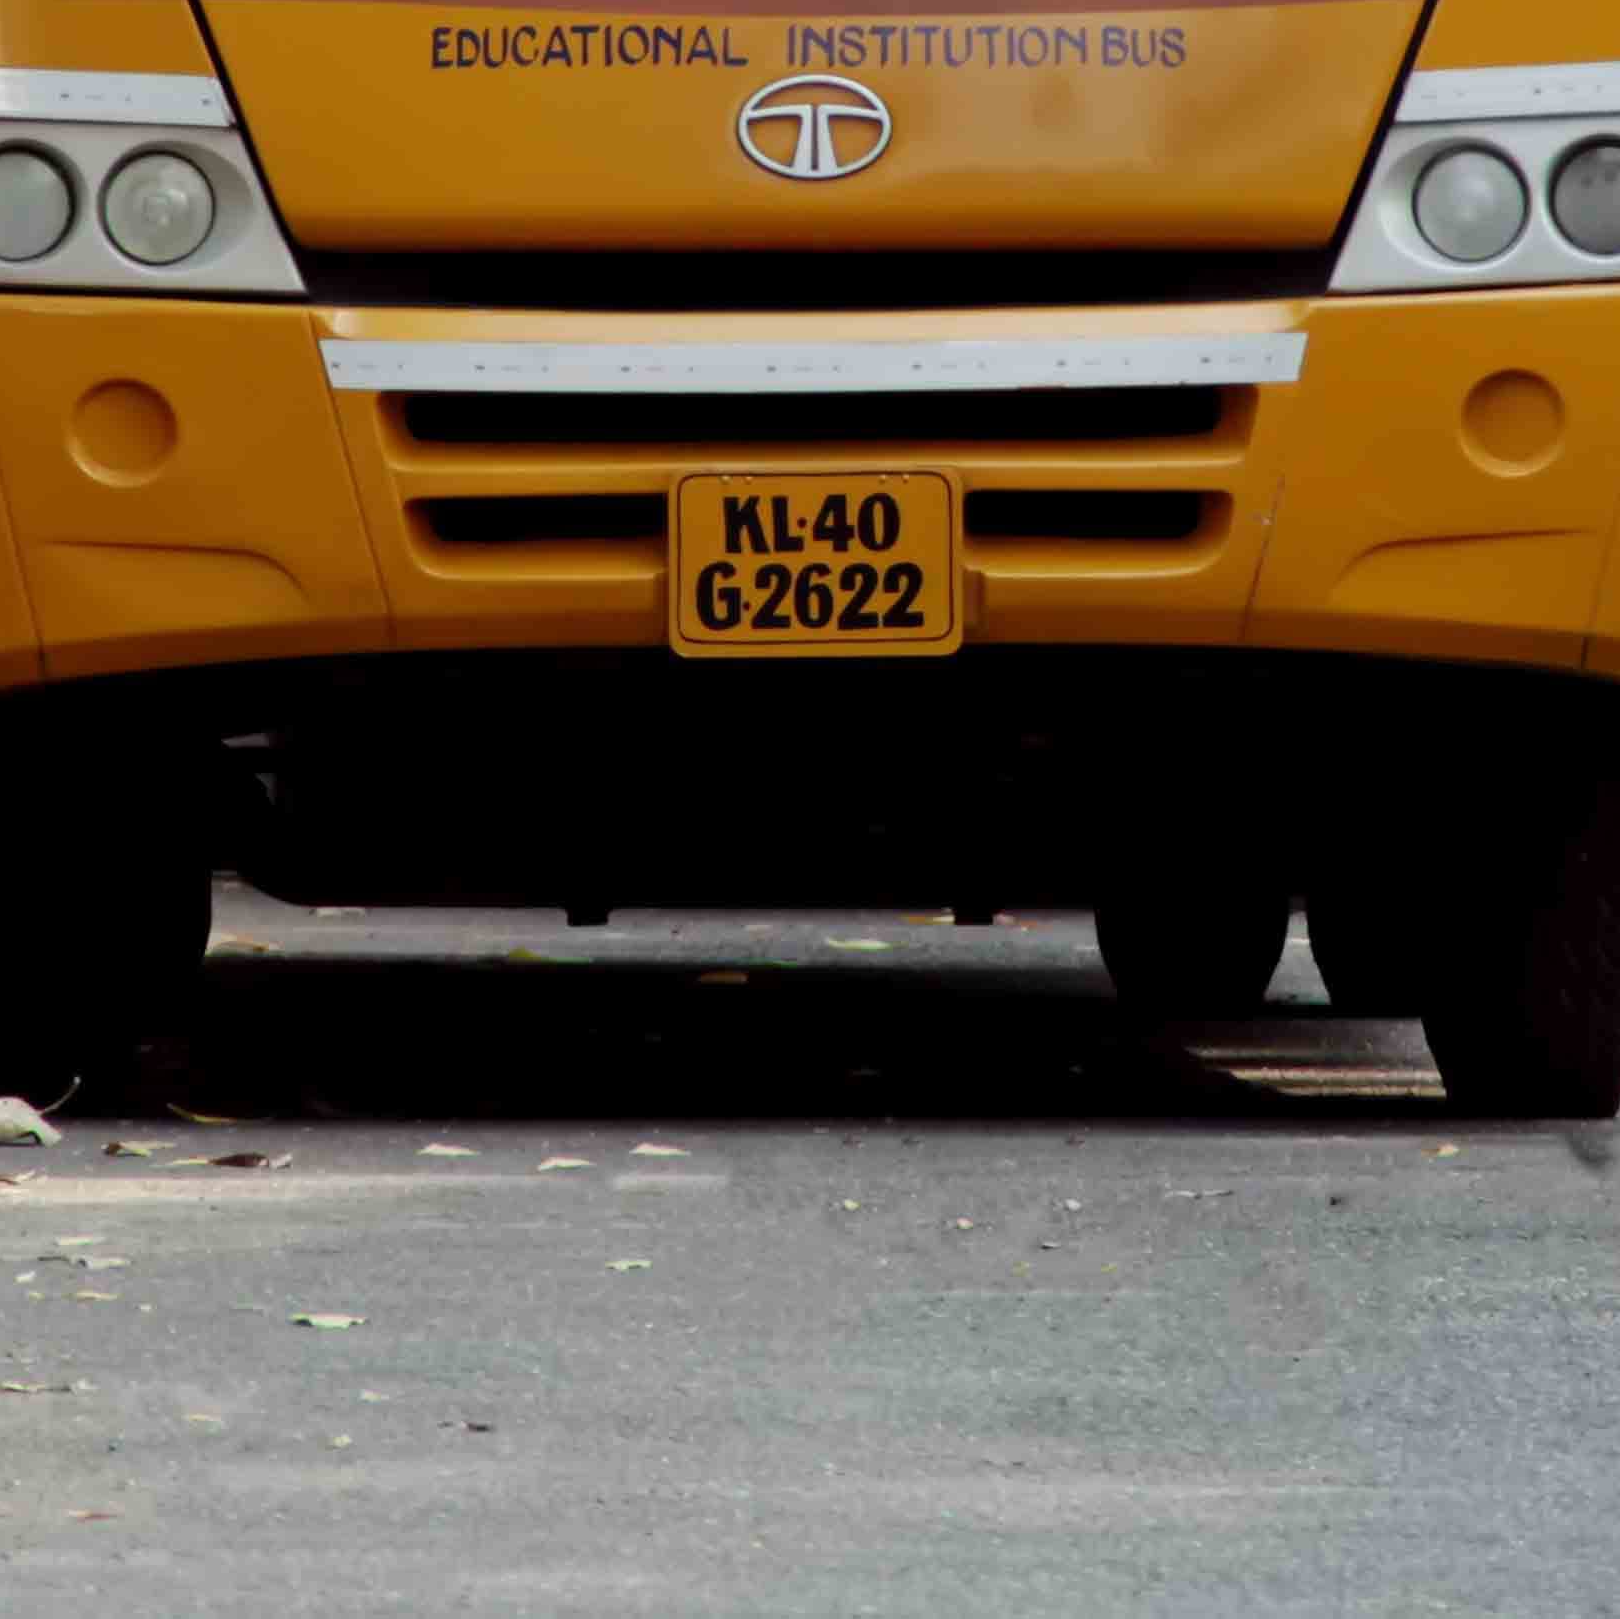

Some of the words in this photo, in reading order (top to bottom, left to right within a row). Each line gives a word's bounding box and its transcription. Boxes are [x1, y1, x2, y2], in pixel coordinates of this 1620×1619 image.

[431, 24, 749, 71] EDUCATIONAL
[785, 24, 1089, 70] INSTITUTION
[1100, 26, 1187, 69] BUS
